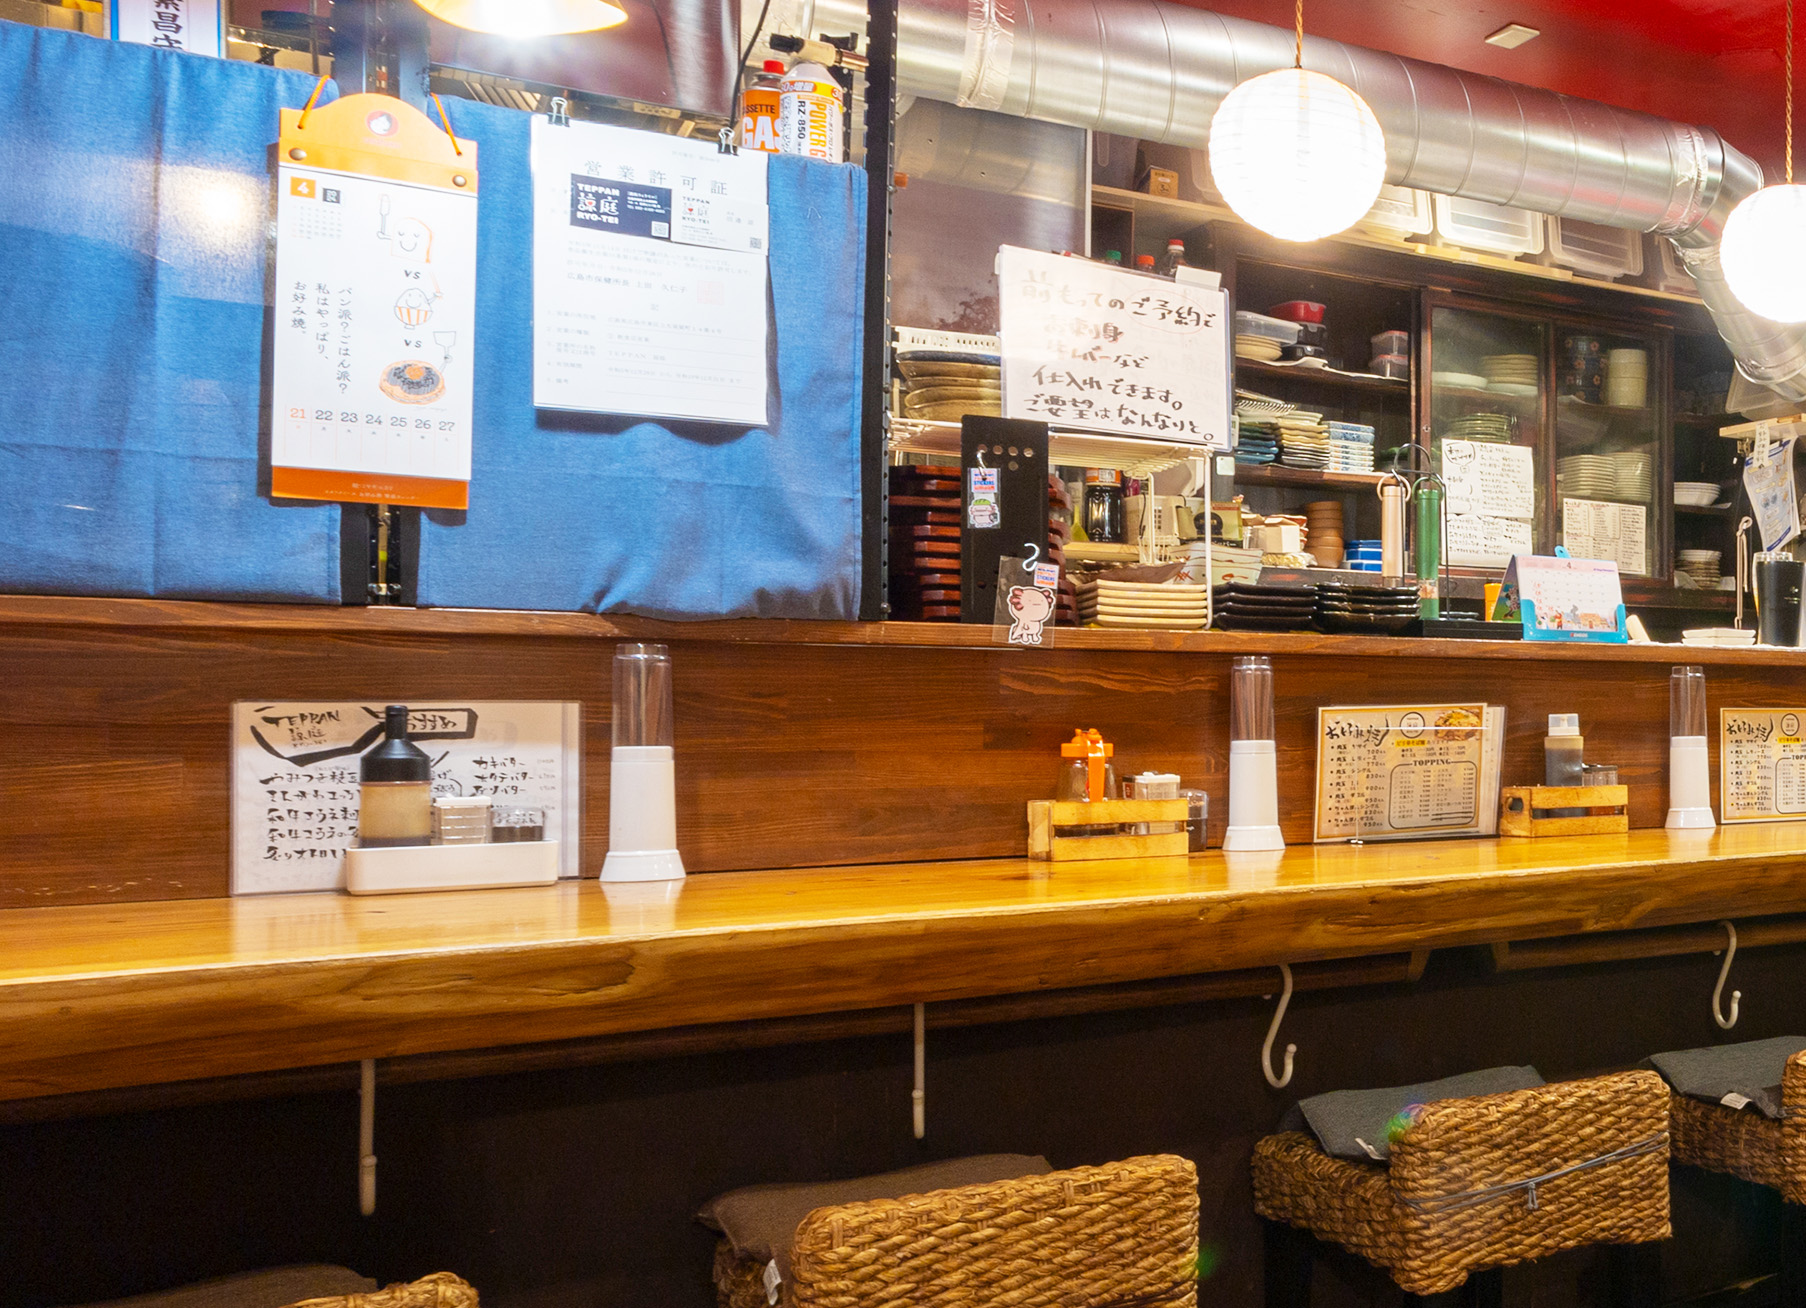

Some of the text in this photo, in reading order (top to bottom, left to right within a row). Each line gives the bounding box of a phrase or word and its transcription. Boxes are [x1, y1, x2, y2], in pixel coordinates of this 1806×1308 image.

[585, 161, 728, 196] 営業許可証
[297, 181, 310, 194] 4
[577, 183, 620, 196] TEPPAN
[577, 211, 619, 225] RYO-TEI
[290, 408, 455, 432] 21 22 23 24 25 26 27
[261, 710, 341, 727] TEPPAN
[408, 714, 457, 730] すすめ
[1413, 759, 1452, 767] TOPPING
